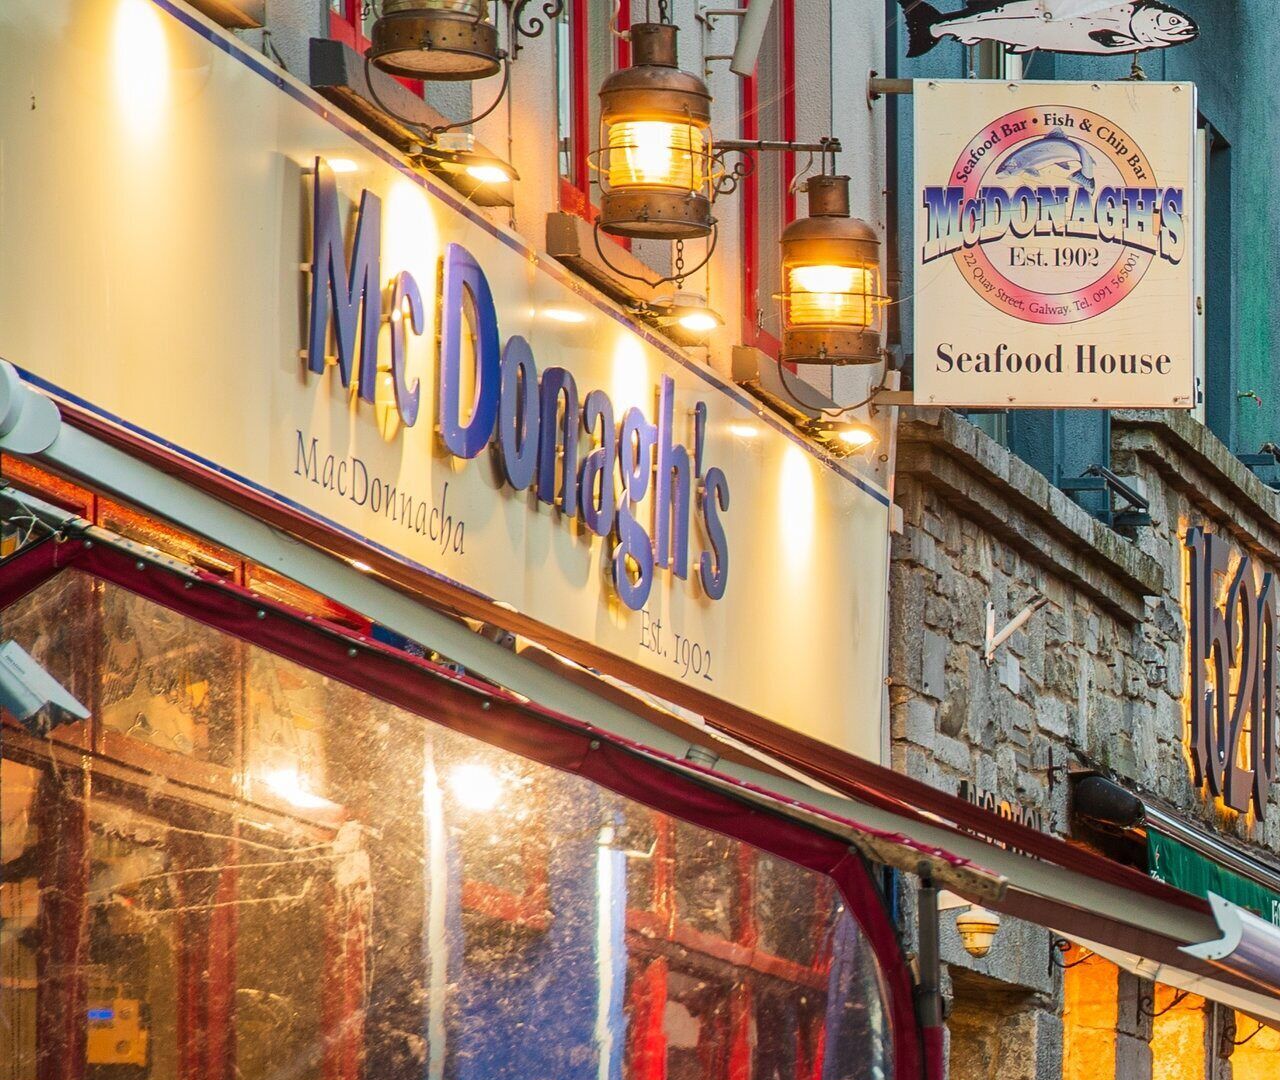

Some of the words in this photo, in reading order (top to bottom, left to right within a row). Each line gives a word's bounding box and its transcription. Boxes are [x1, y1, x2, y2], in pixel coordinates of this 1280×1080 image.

[956, 130, 1002, 183] Seafood
[1000, 118, 1028, 138] Bar
[1043, 113, 1074, 128] Fish
[1079, 118, 1092, 132] &
[1096, 126, 1128, 156] Chip
[1127, 154, 1148, 182] Bar
[962, 252, 975, 268] 22
[972, 267, 995, 293] Quay
[1075, 298, 1092, 311] Tel.
[1092, 286, 1112, 303] 091
[1111, 252, 1140, 288] 565001
[1007, 247, 1048, 267] Est.
[1052, 247, 1100, 267] 1902
[936, 343, 1063, 374] Seafood
[1075, 344, 1172, 375] House
[294, 429, 466, 556] MacDonnacha
[639, 608, 668, 659] Est.
[672, 630, 714, 682] 1902
